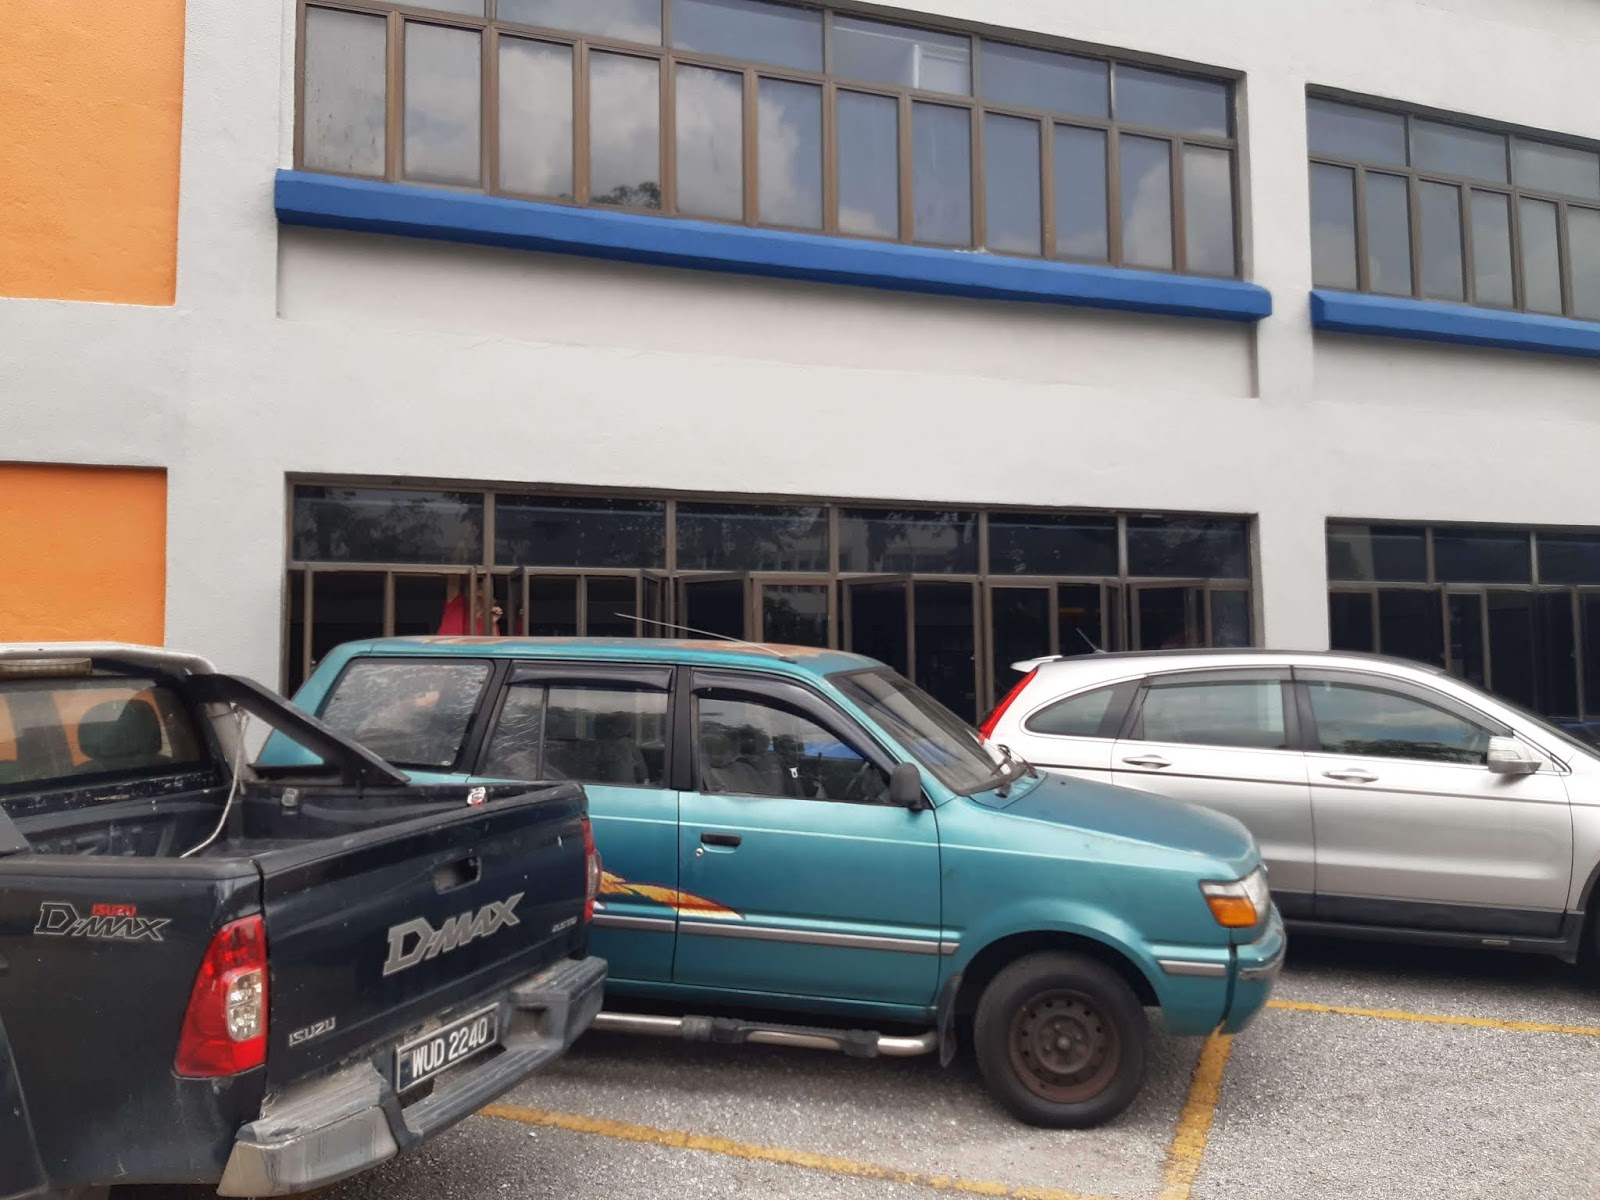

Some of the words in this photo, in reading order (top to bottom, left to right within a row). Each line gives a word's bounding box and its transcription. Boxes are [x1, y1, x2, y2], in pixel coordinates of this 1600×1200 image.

[92, 903, 137, 917] ISUZU
[289, 1016, 336, 1047] ISUZU
[412, 1038, 445, 1078] WUD
[448, 1018, 488, 1061] 2240
